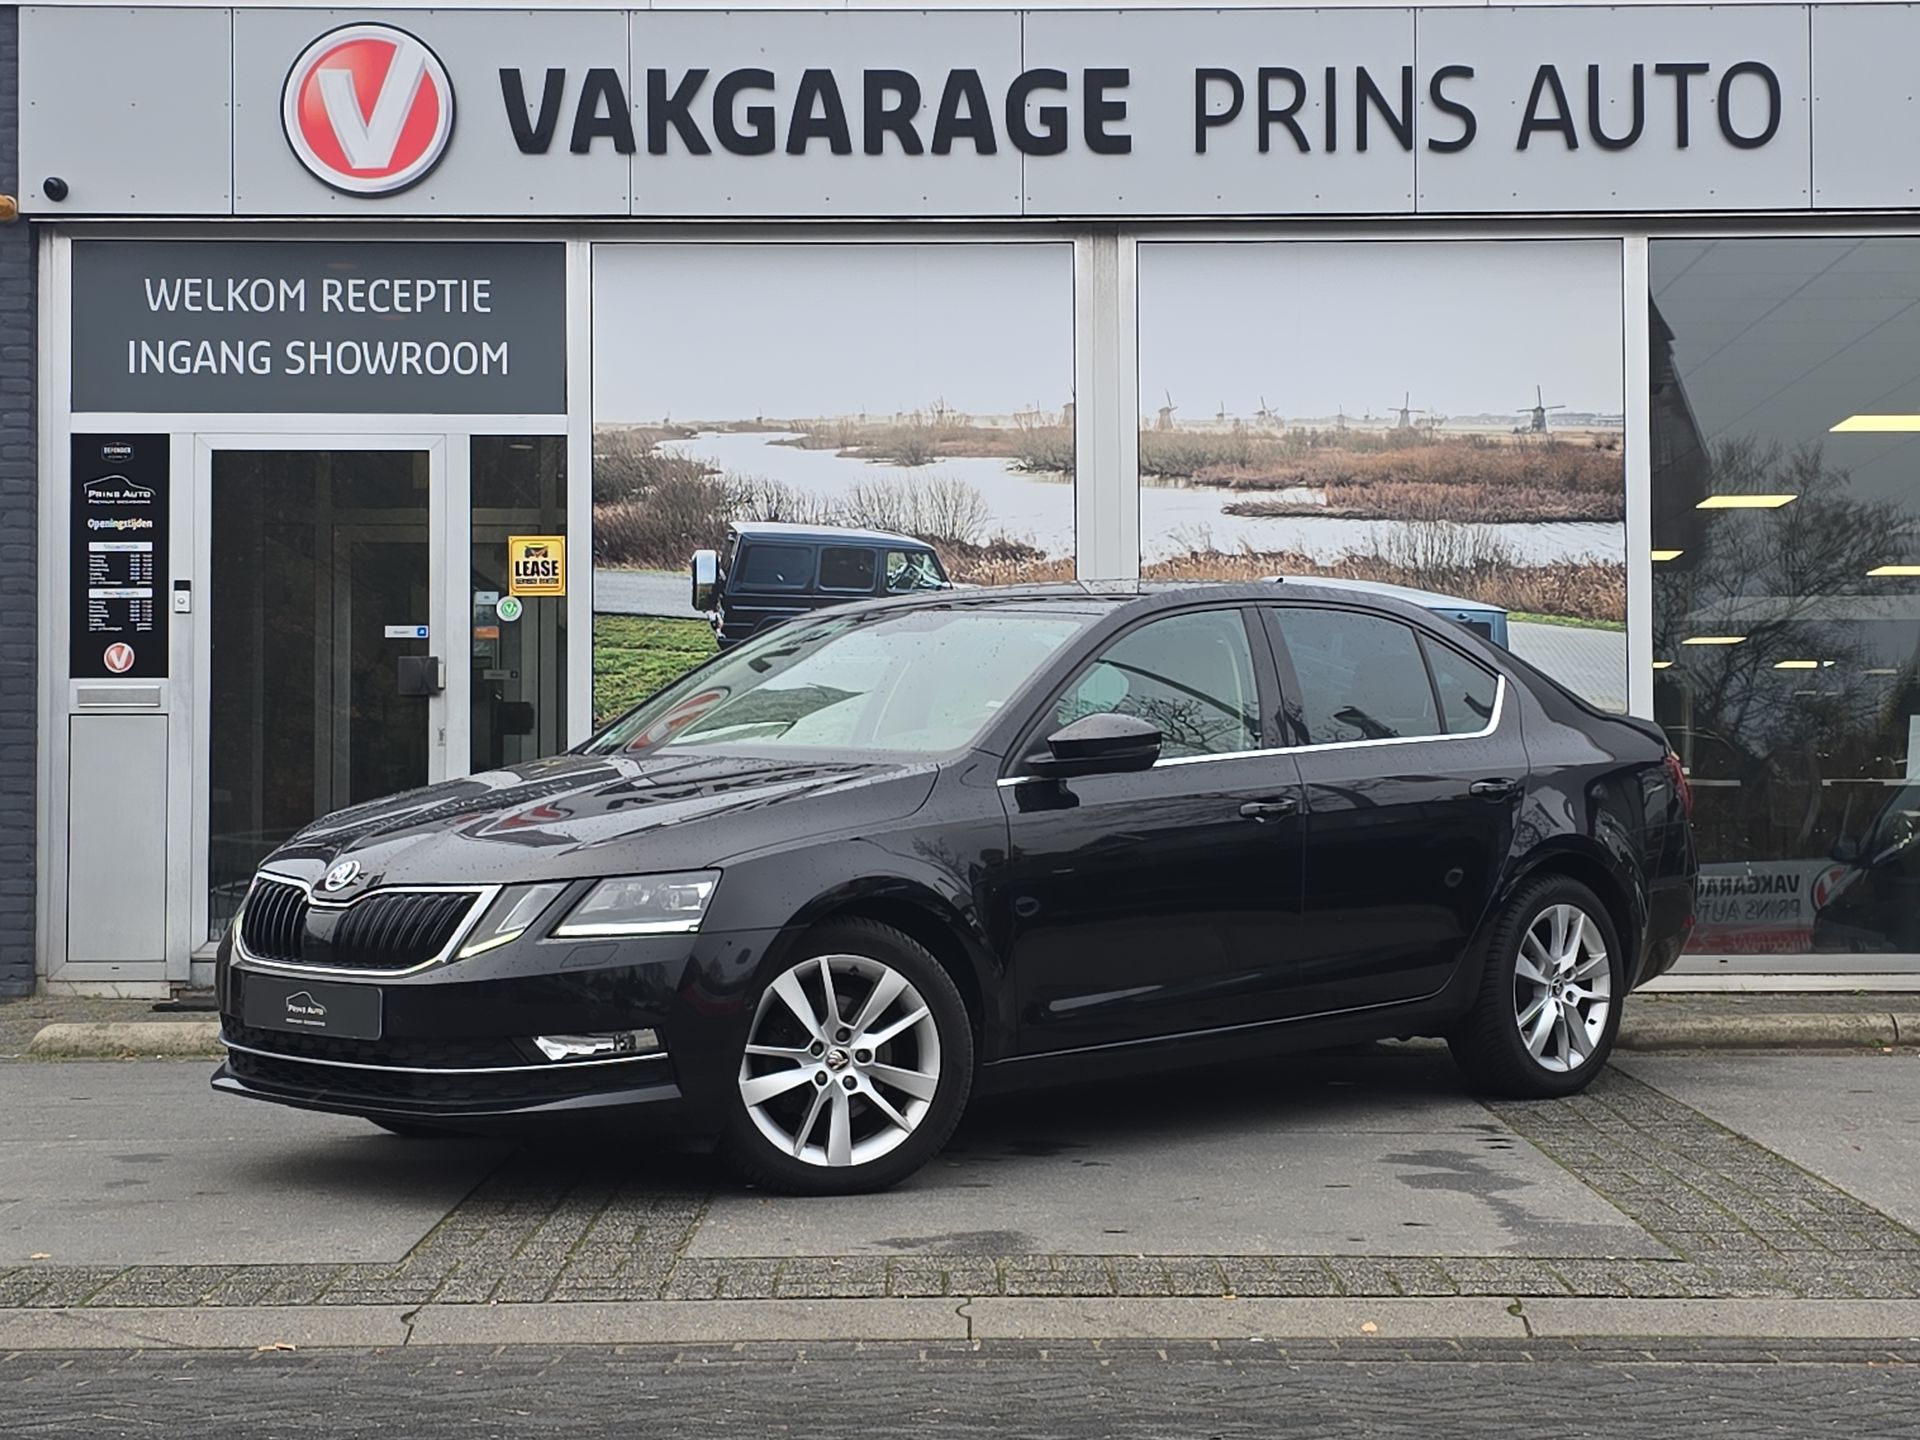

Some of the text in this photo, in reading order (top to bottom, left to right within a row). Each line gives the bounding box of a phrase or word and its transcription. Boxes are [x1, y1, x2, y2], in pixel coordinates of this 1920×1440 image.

[498, 61, 1781, 156] VAKGARAGE PRINS AUTO
[144, 278, 491, 314] WELKOM RECEPTIE
[128, 340, 508, 375] INGANG SHOWROOM
[87, 518, 153, 531] Openingstijden
[515, 560, 559, 577] LEASE
